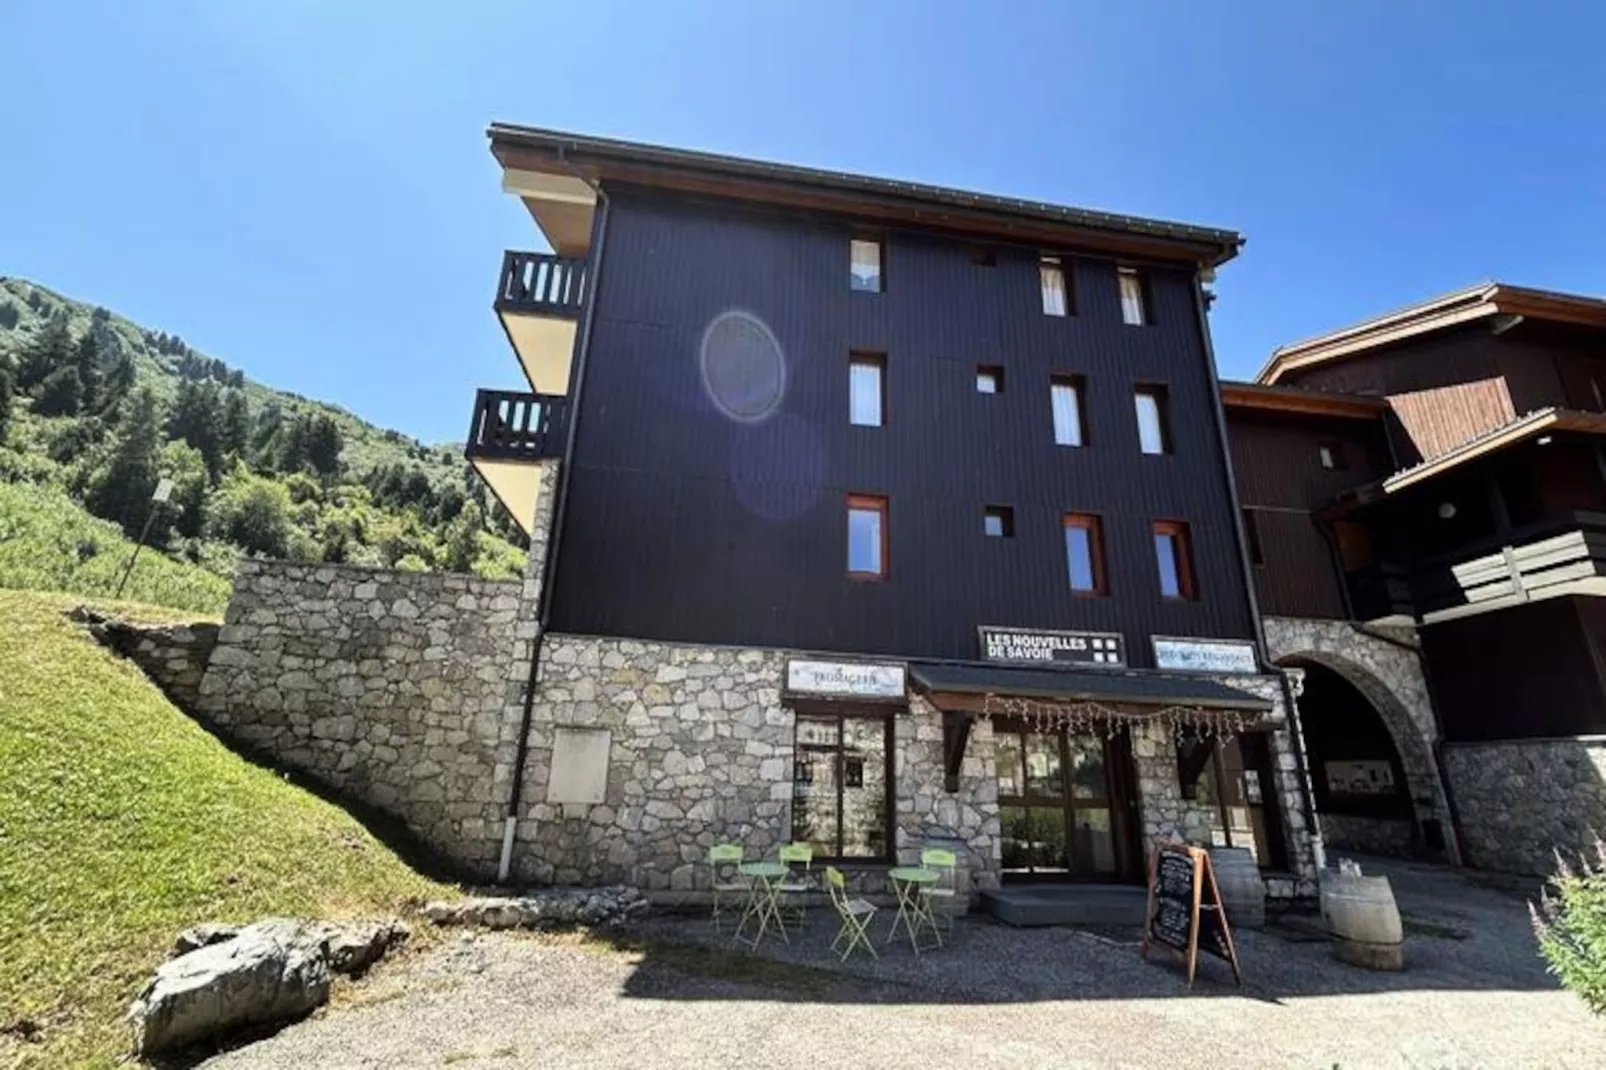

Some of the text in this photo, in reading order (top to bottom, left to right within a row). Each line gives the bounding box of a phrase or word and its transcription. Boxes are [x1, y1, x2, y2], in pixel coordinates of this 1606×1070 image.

[987, 631, 1087, 650] LES NOUVELLES
[988, 645, 1053, 661] DE SAVOIE
